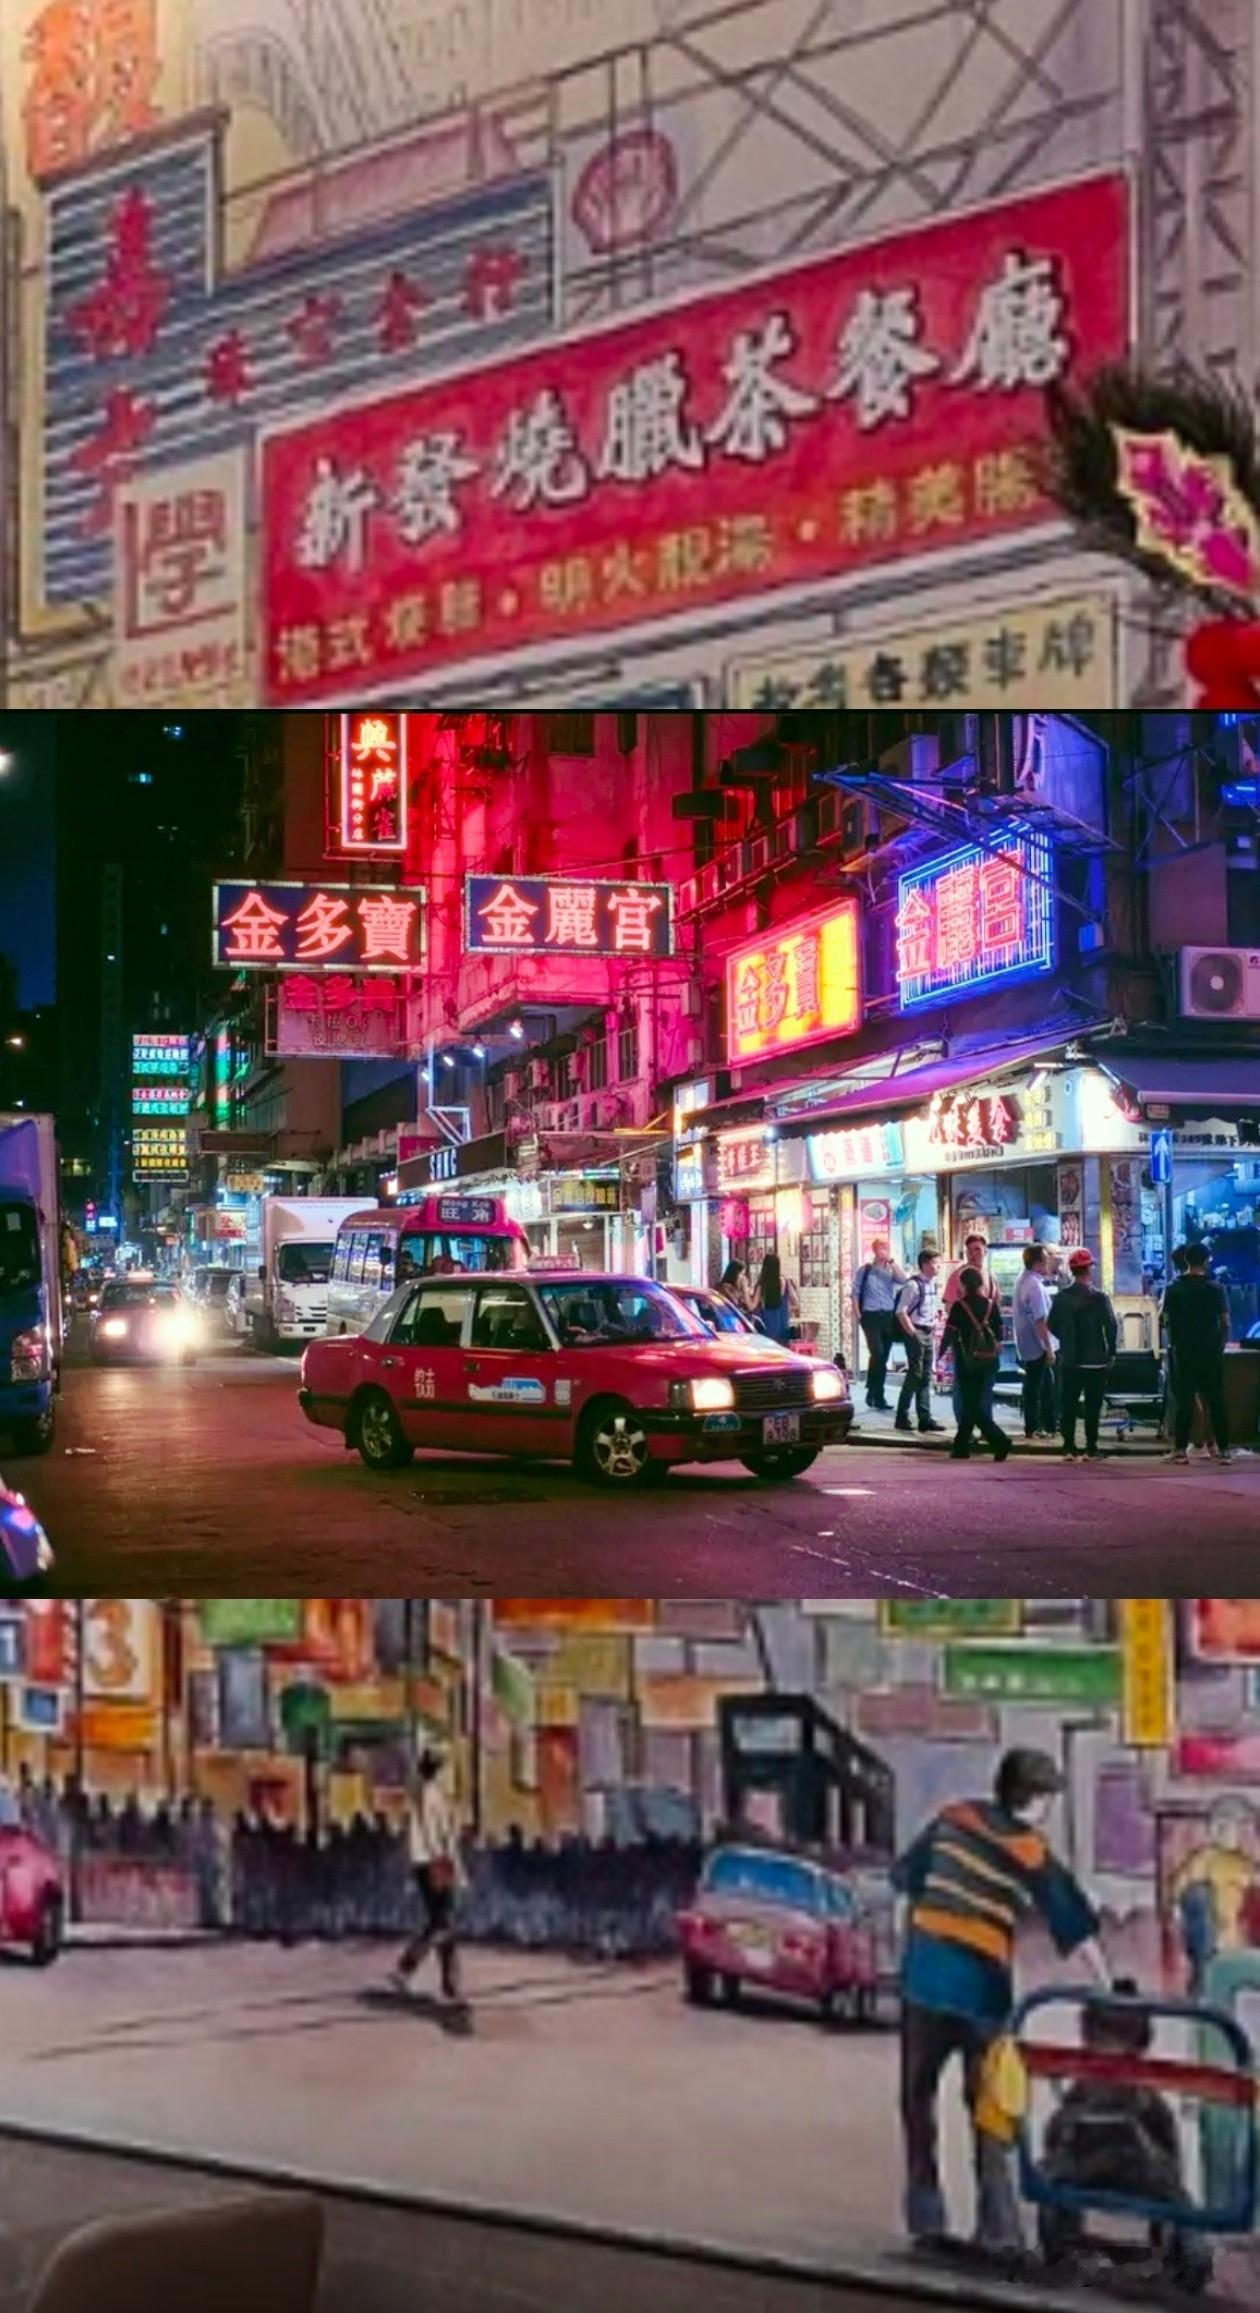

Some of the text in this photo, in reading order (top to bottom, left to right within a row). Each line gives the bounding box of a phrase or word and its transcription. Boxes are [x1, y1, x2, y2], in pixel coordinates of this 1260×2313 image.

[221, 892, 417, 961] 金多寶
[442, 1199, 490, 1209] Mong Kok
[441, 1207, 490, 1221] 旺角
[414, 1367, 436, 1384] 的士
[414, 1383, 436, 1399] TAXI
